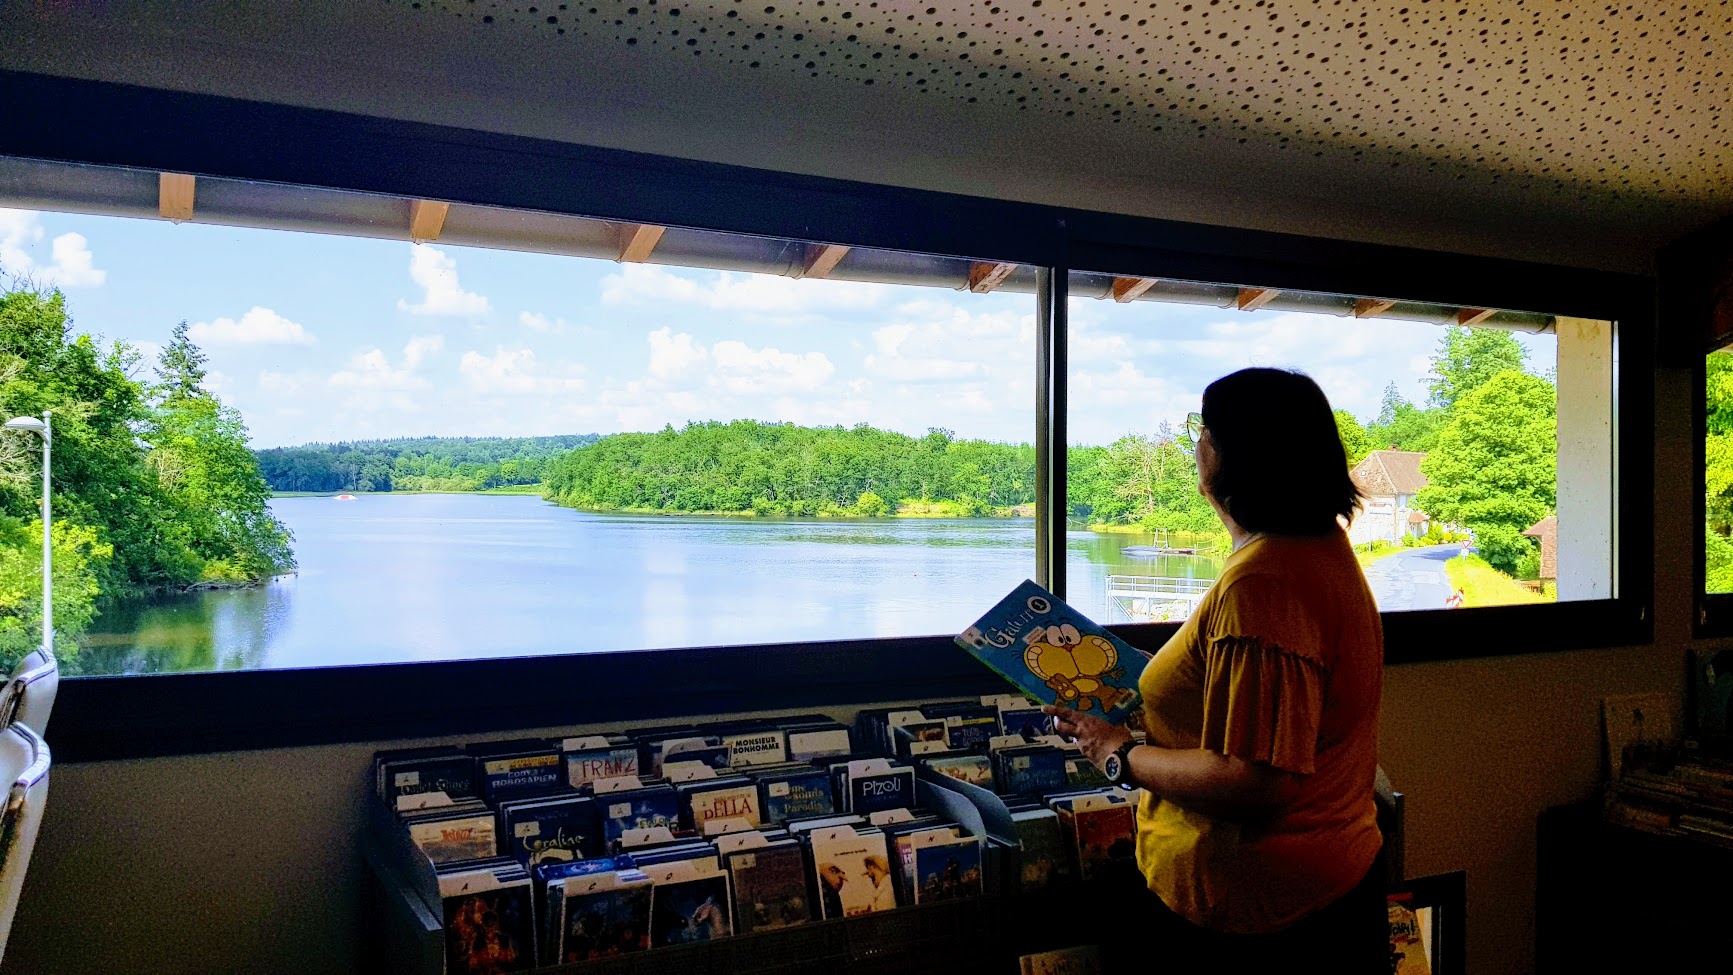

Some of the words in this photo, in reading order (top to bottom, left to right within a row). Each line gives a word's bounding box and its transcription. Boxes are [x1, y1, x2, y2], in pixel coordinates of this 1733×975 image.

[735, 737, 776, 747] MONSIEUR
[733, 743, 779, 755] BONHOMME
[582, 756, 636, 778] FRANZ
[863, 777, 901, 796] PIZOU
[523, 827, 585, 852] Coraline
[461, 882, 468, 891] A
[588, 882, 596, 890] C
